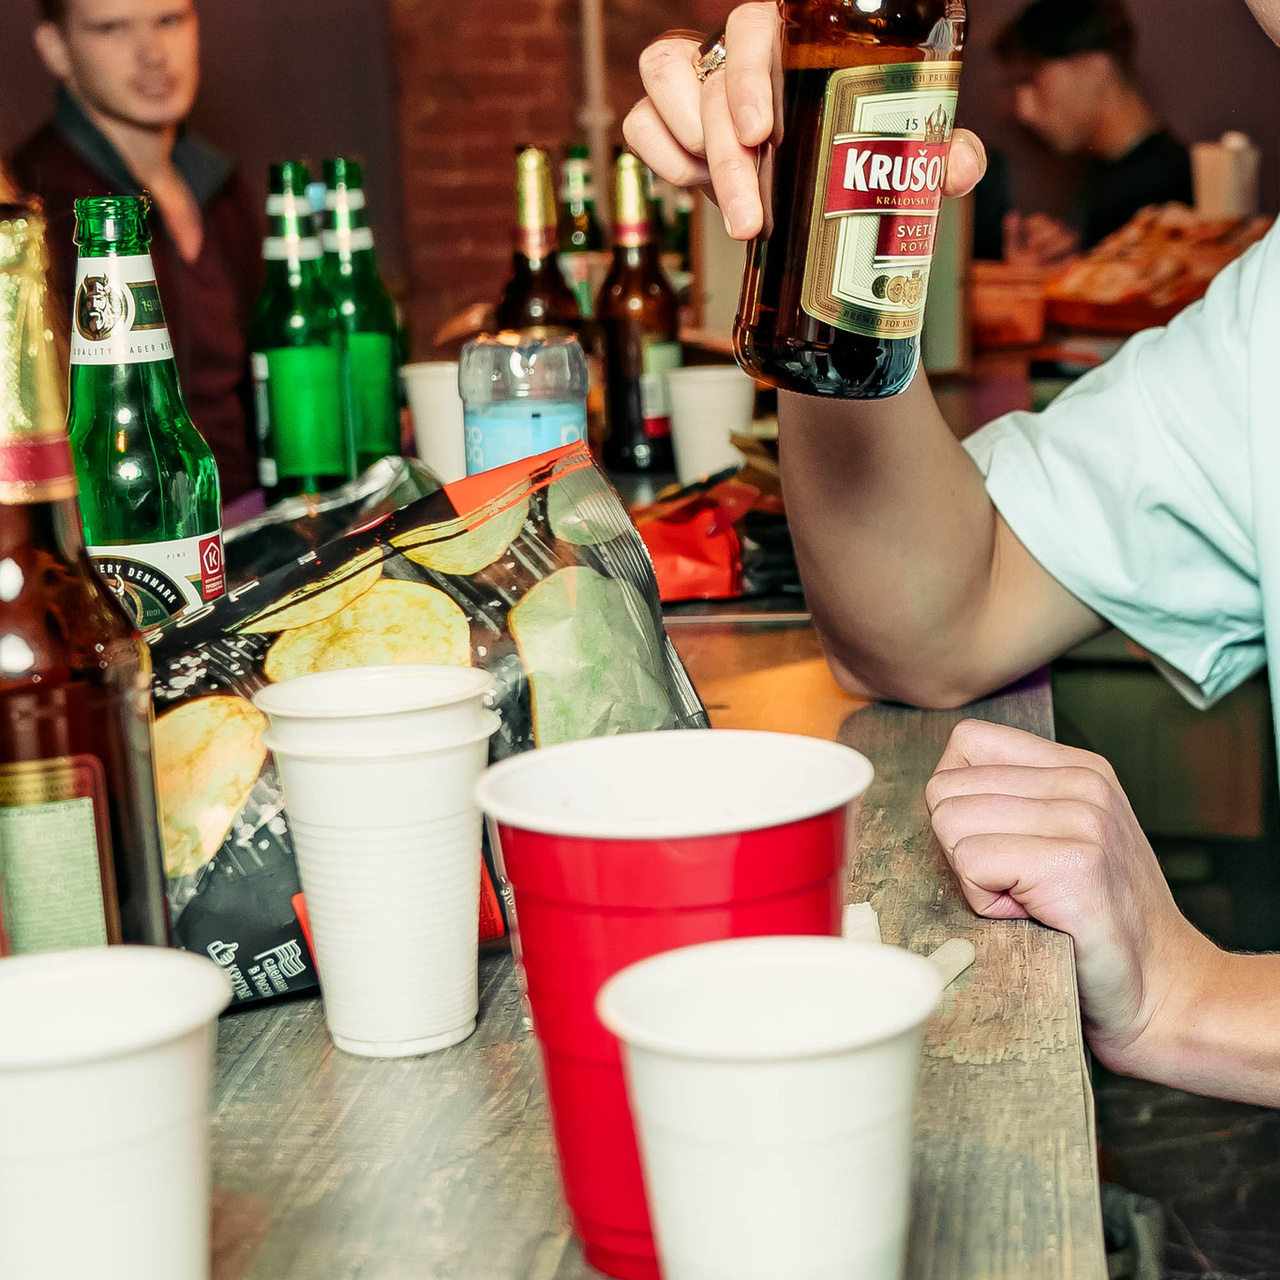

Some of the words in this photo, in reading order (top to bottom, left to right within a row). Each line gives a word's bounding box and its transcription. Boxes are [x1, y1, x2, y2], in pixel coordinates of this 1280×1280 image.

[905, 118, 918, 131] 15
[885, 318, 900, 328] FOR
[129, 344, 156, 354] AGER
[127, 566, 178, 604] DENMARK
